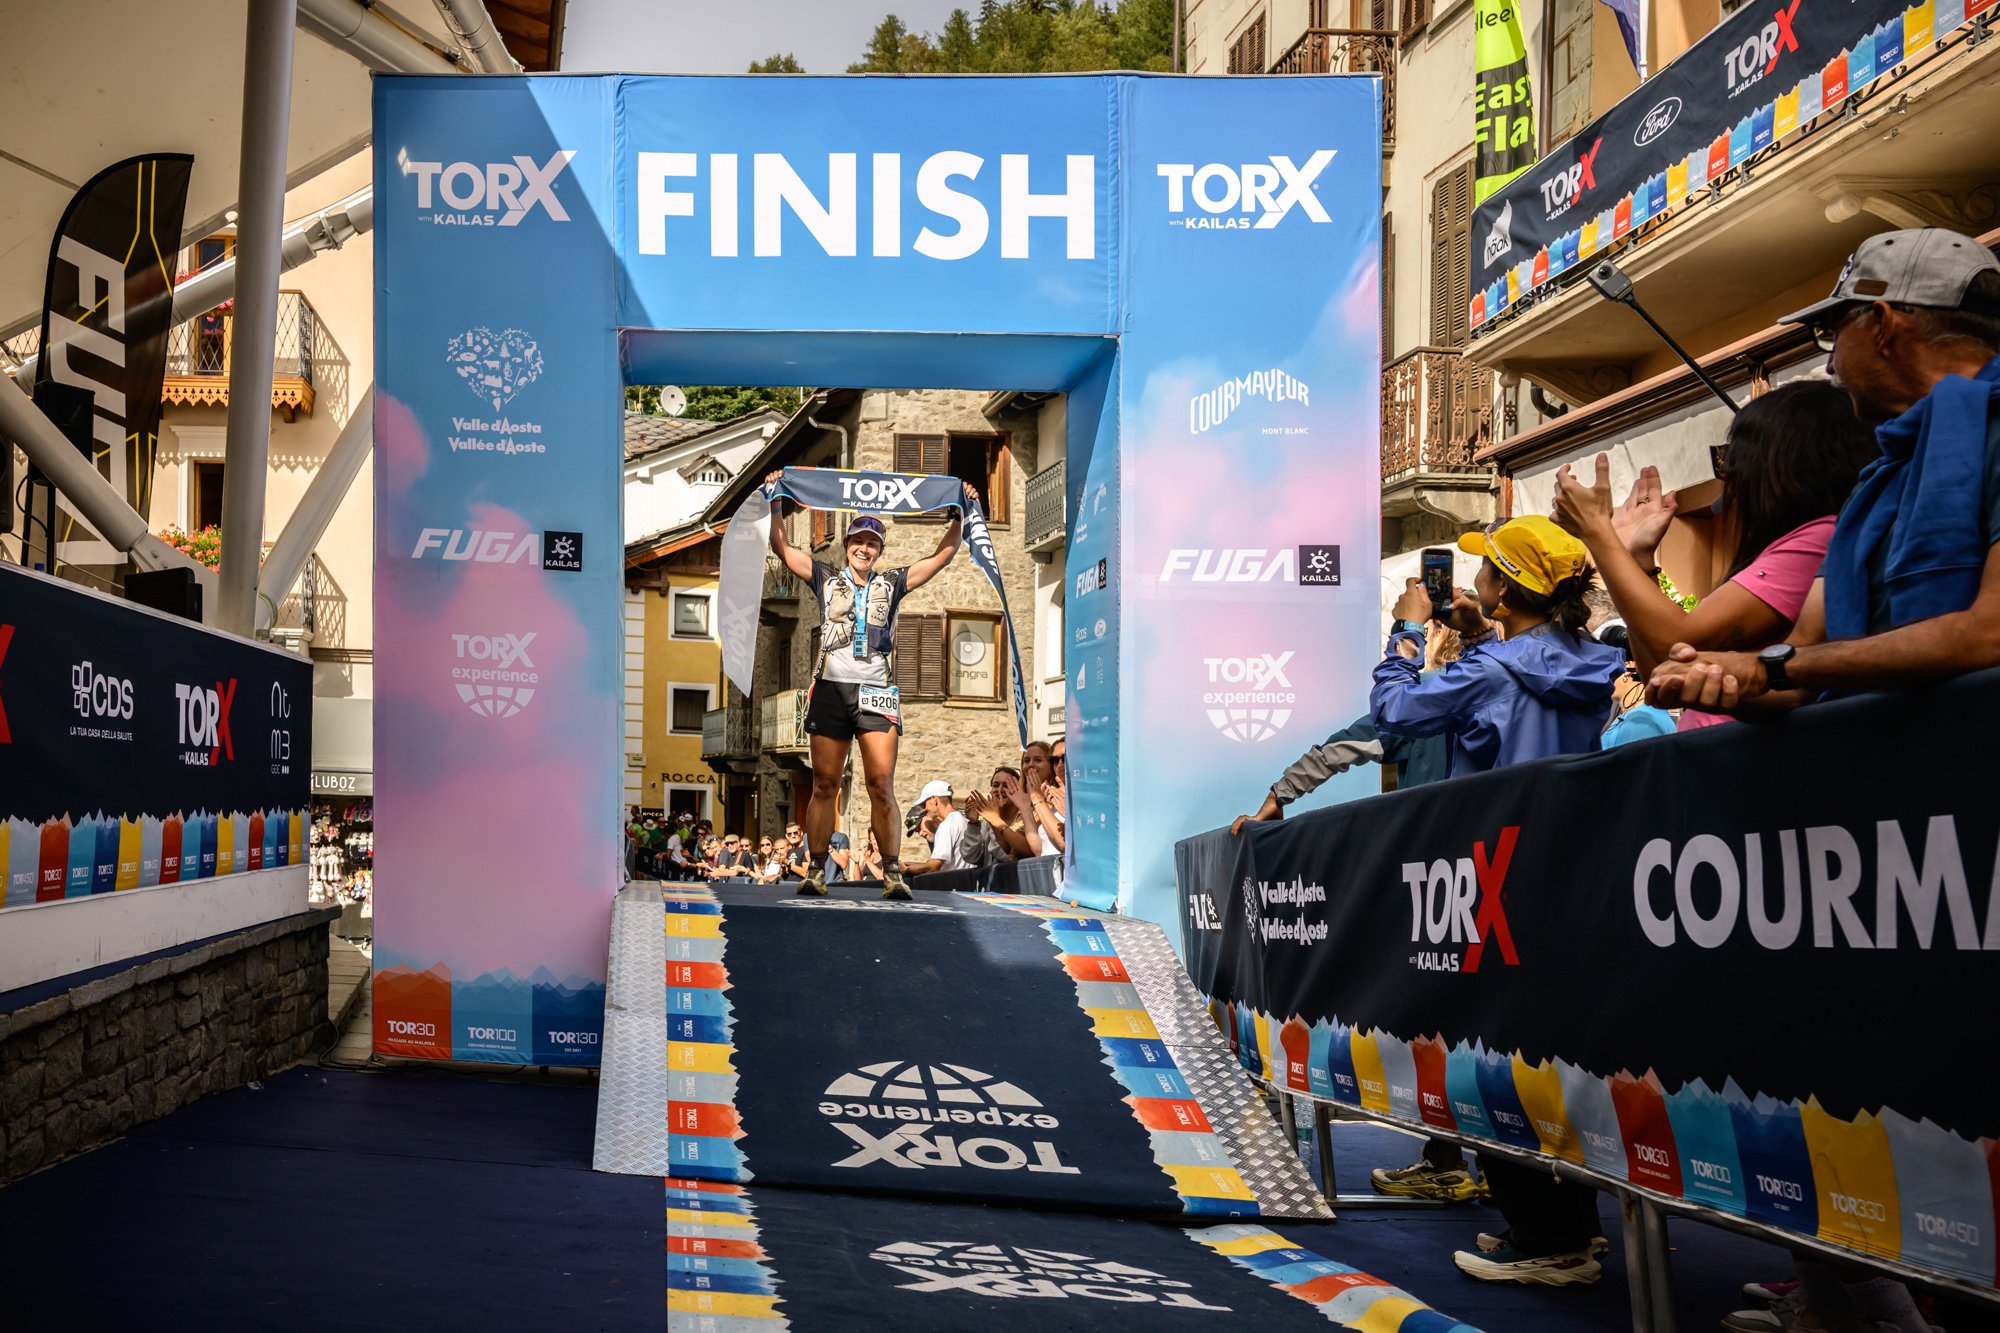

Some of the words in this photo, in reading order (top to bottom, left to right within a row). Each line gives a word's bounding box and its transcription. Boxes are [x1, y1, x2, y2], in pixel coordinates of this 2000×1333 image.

[1724, 0, 1800, 89] TORX
[1880, 46, 1899, 62] TOR130
[1852, 64, 1870, 80] TOR100
[1735, 69, 1764, 97] KAILAS
[1827, 81, 1843, 97] TOR30
[1476, 115, 1534, 152] Fla
[1642, 105, 1672, 142] Ford
[1540, 137, 1603, 213] TORX
[408, 150, 577, 226] TORX
[1157, 150, 1338, 229] TORX
[637, 150, 1095, 260] FINISH
[434, 214, 495, 226] KAILAS
[1186, 218, 1250, 229] KAILAS
[1487, 237, 1509, 261] näak
[1190, 368, 1309, 435] COURMAYEUR
[452, 417, 490, 433] Valle
[1262, 427, 1283, 435] MONT
[1285, 427, 1309, 435] BLANC
[448, 437, 495, 454] Vallée
[839, 477, 927, 509] TORX
[850, 501, 882, 509] KAILAS
[411, 527, 540, 565] FUGA
[545, 559, 580, 568] KAILAS
[1159, 549, 1294, 582] FUGA
[1075, 564, 1099, 599] FUGA
[1301, 574, 1339, 582] KAILAS
[452, 632, 538, 668] TORX
[451, 667, 538, 684] experience
[1203, 651, 1295, 690] TORX
[93, 673, 134, 720] CDS
[872, 696, 897, 710] 5206
[1203, 690, 1295, 706] experience
[176, 678, 237, 766] TORX
[70, 727, 76, 736] LA
[77, 727, 87, 737] TUA
[88, 728, 100, 738] CASA
[101, 730, 116, 740] DELLA
[117, 731, 133, 741] SALUTE
[185, 751, 209, 766] KAILAS
[315, 775, 356, 789] LUBOZ
[661, 773, 716, 784] ROCCA
[44, 868, 62, 882] TOR30
[72, 866, 88, 878] TOR100
[98, 864, 114, 876] TOR130
[1633, 814, 2000, 950] COURM
[1258, 882, 1287, 909] Valle
[1402, 826, 1521, 973] TORX
[1260, 918, 1293, 946] Vallée
[1417, 952, 1459, 972] KAILAS
[387, 1020, 435, 1037] TOR30
[468, 1026, 516, 1042] TOR100
[549, 1031, 597, 1044] TOR130
[684, 1020, 692, 1037] TOR130
[1140, 1044, 1156, 1062] TOR130
[1362, 1079, 1382, 1094] TOR330
[1423, 1092, 1444, 1109] TOR30
[1455, 1102, 1481, 1118] TOR100
[687, 1108, 698, 1129] TOR30
[818, 1101, 1059, 1129] experience
[1173, 1105, 1191, 1125] TOR30
[1494, 1110, 1524, 1128] TOR130
[1536, 1119, 1569, 1139] TOR330
[688, 1142, 698, 1160] TOR100
[830, 1122, 1081, 1174] TORX
[1583, 1130, 1618, 1152] TOR450
[1634, 1144, 1669, 1167] TOR30
[1690, 1158, 1731, 1184] TOR100
[1756, 1174, 1802, 1201] TOR130
[1830, 1192, 1886, 1222] TOR330
[1915, 1212, 1979, 1246] TOR450
[868, 1252, 1193, 1288] experience
[886, 1264, 1234, 1311] TORX
